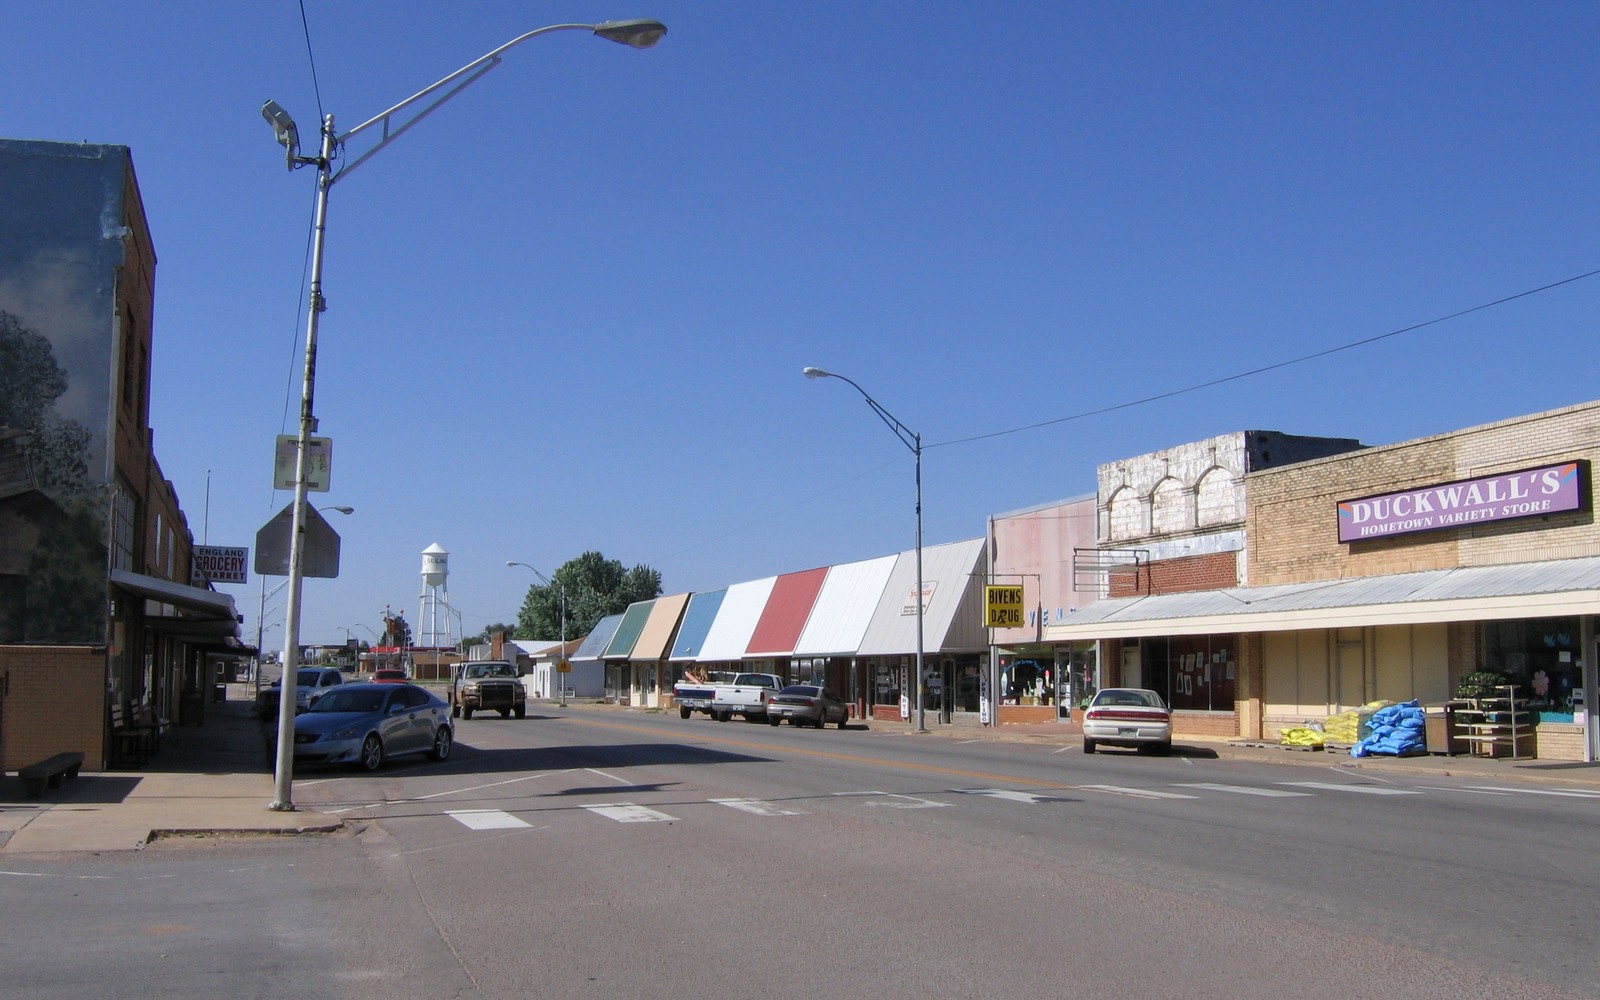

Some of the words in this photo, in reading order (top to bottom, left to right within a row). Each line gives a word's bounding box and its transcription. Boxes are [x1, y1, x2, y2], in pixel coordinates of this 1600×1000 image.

[1351, 470, 1560, 524] DUCKWALL'S
[1360, 516, 1433, 536] HOMETOWN
[1439, 507, 1497, 525] VARIETY
[1502, 499, 1551, 516] STORE
[200, 548, 244, 557] ENGLAND
[196, 555, 245, 571] GROCERY
[989, 589, 1021, 604] BIVENS
